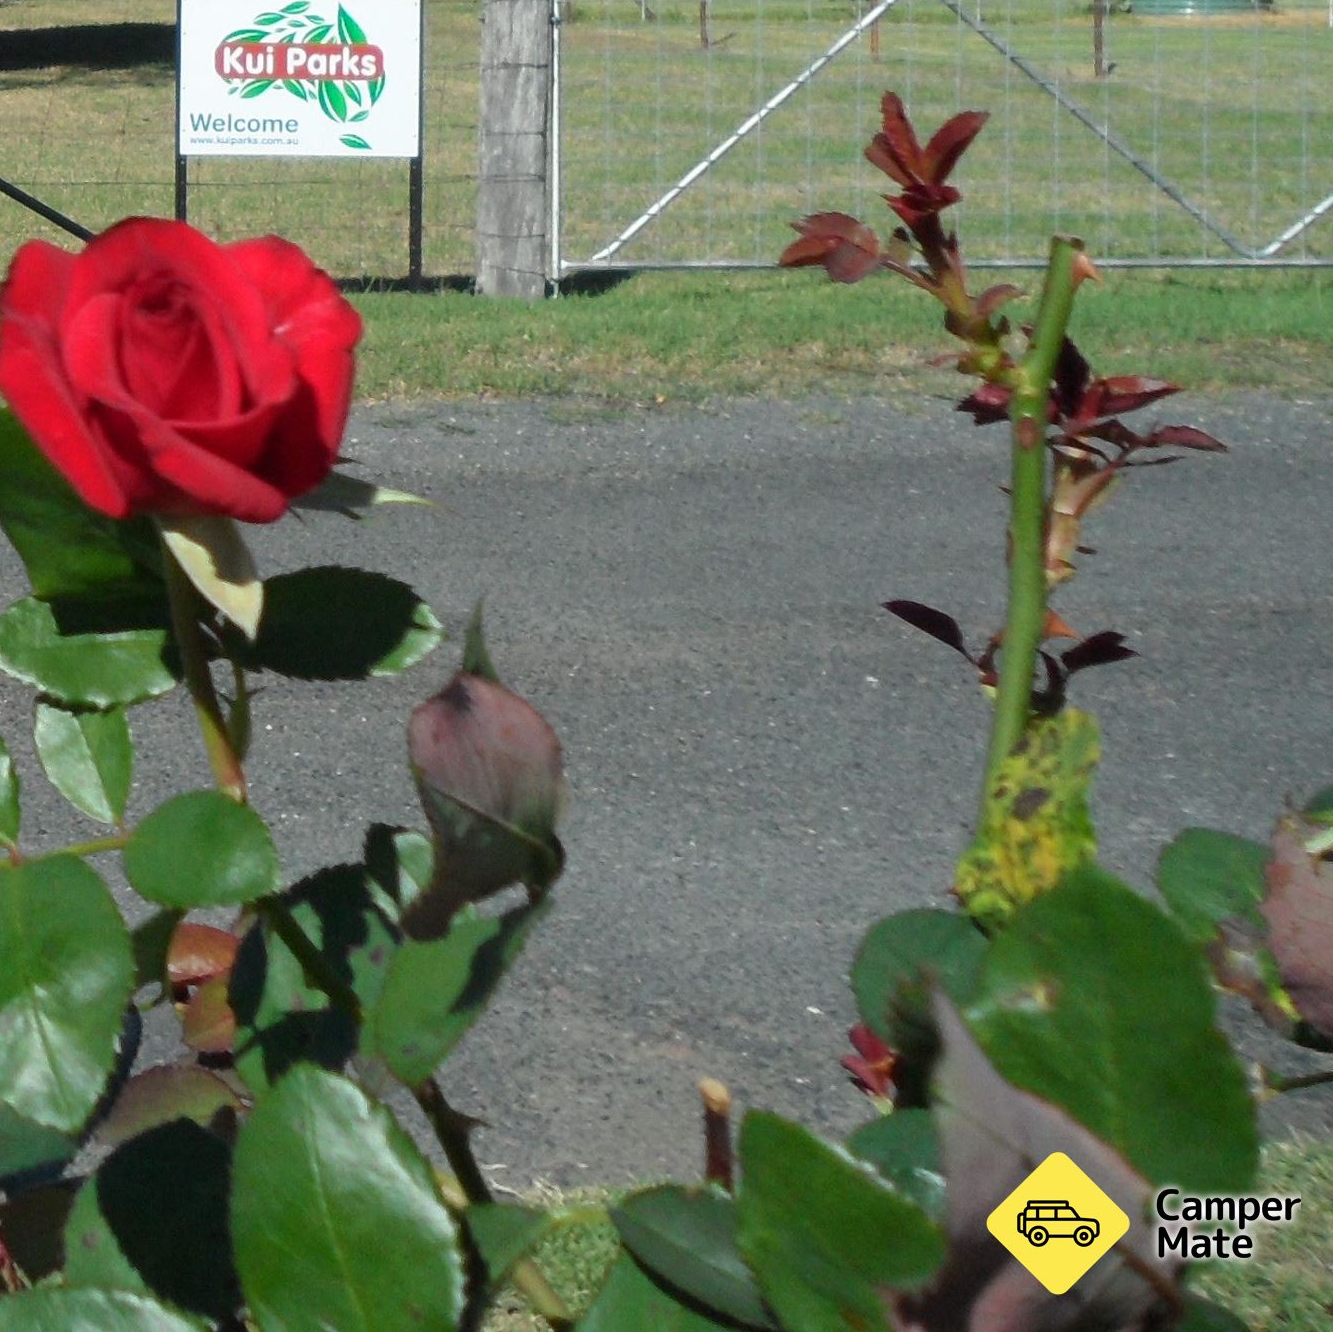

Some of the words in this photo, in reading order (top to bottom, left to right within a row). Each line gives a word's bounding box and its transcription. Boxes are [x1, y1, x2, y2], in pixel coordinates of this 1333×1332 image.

[222, 46, 275, 76] Kui
[286, 47, 376, 77] Parks
[190, 113, 299, 133] Welcome
[190, 136, 299, 146] www.kuiparks.com.au
